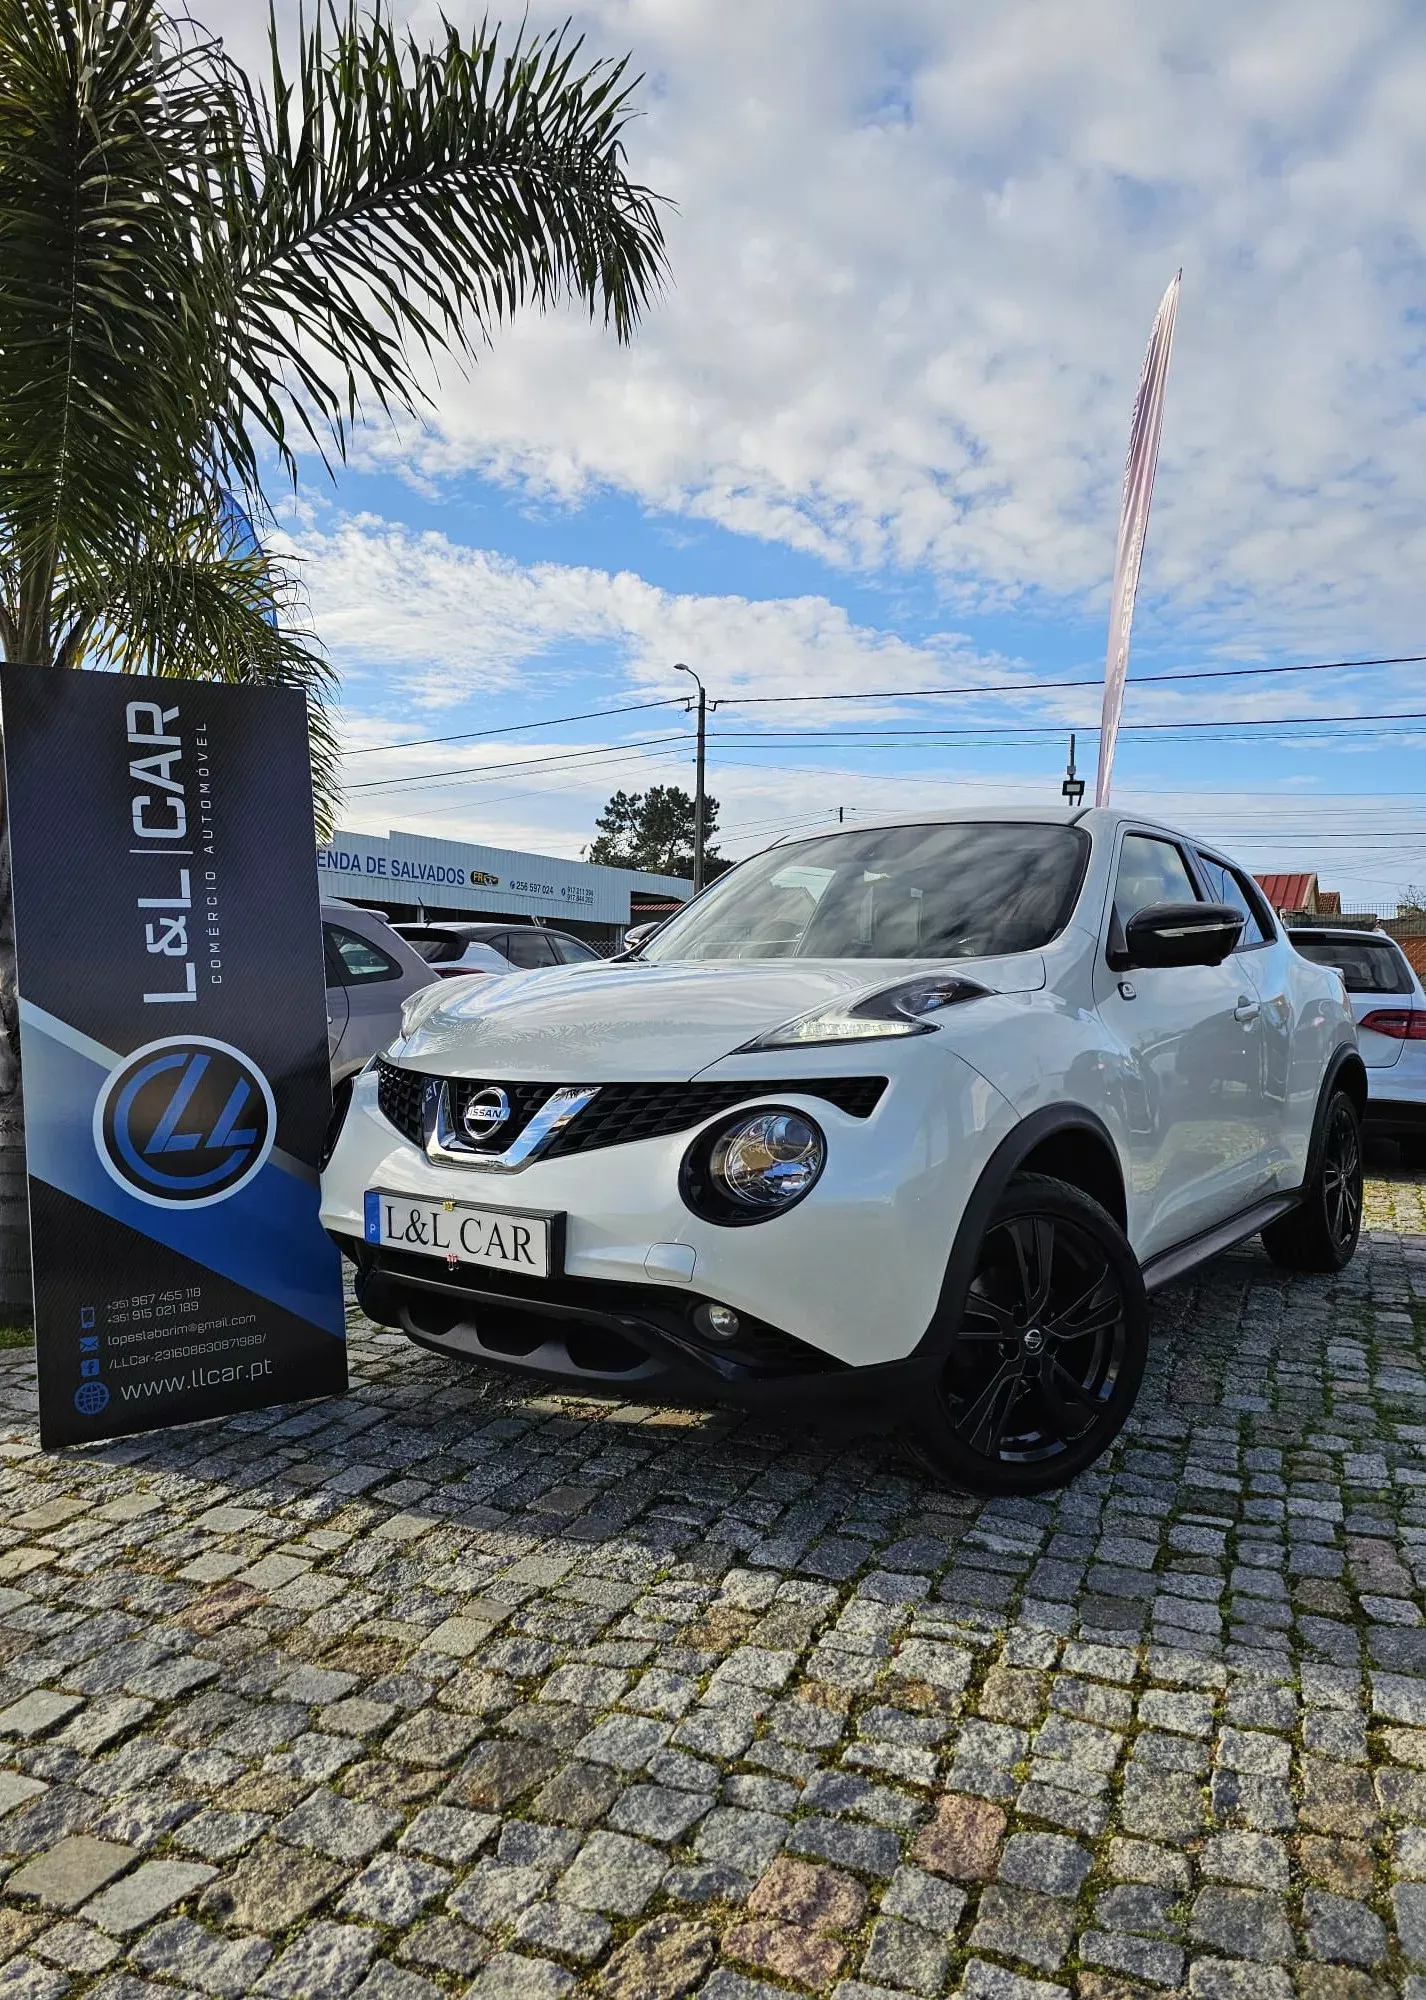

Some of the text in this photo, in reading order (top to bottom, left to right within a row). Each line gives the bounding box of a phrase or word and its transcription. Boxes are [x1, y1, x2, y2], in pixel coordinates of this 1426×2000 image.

[126, 701, 187, 839] CAR
[196, 723, 222, 984] COMÉRCIO AUTOMÓVEL
[366, 855, 387, 875] DE
[390, 859, 465, 885] SALVADOS
[369, 1222, 376, 1234] P
[385, 1205, 536, 1265] L&L CAR
[132, 1308, 152, 1320] 915
[156, 1305, 176, 1317] 021
[159, 1290, 182, 1302] 455
[186, 1287, 201, 1298] 118
[121, 1359, 273, 1401] www.llcar.pt
